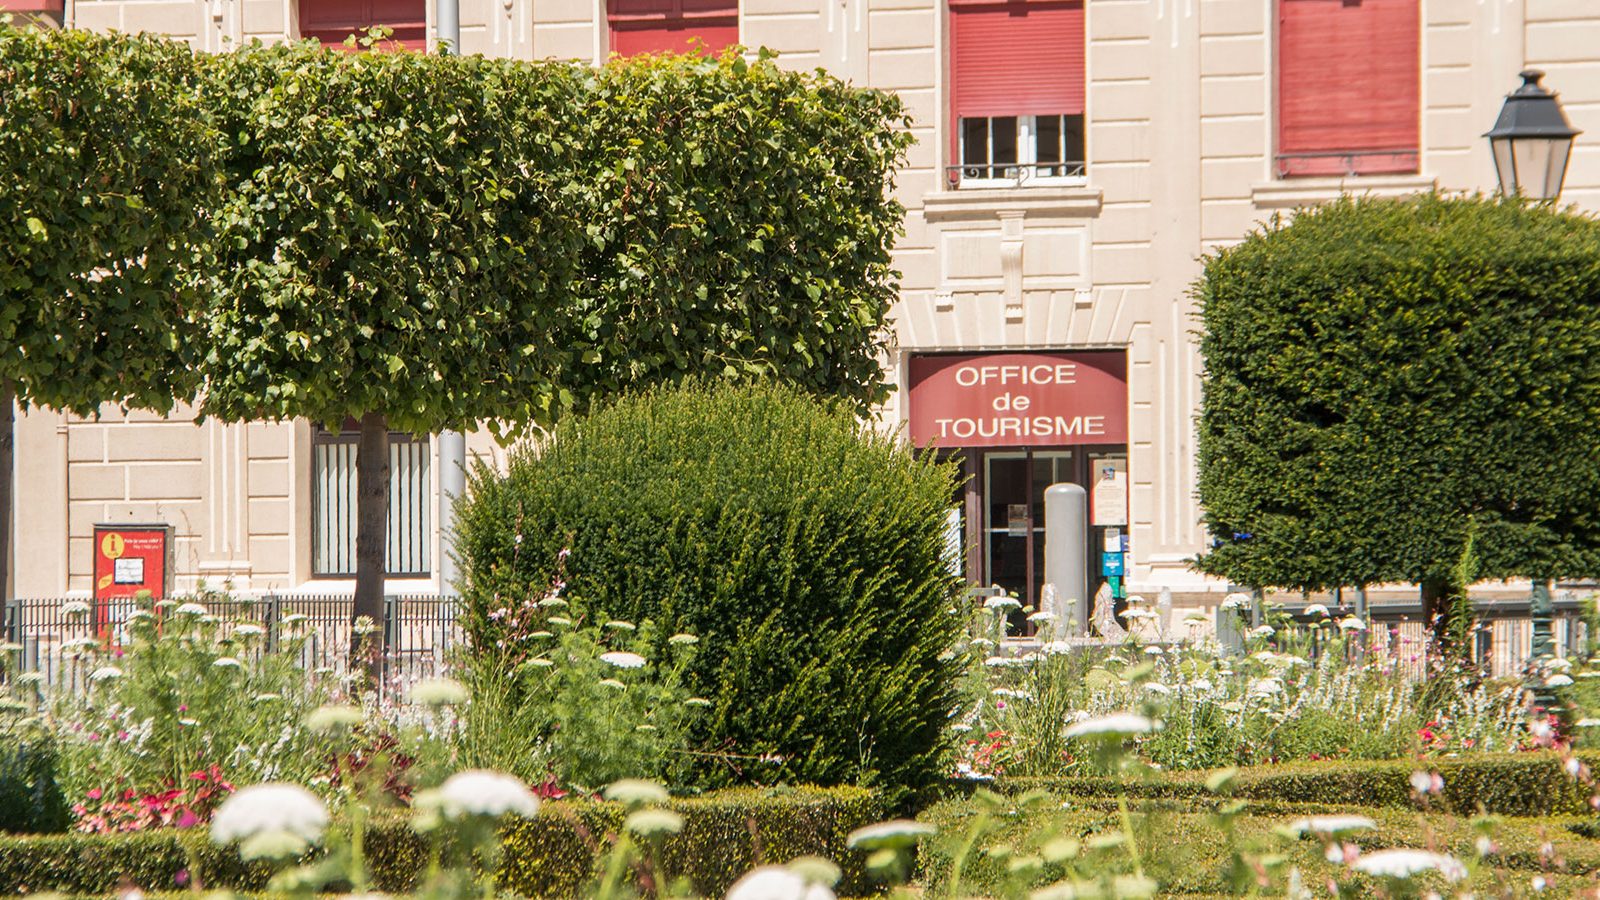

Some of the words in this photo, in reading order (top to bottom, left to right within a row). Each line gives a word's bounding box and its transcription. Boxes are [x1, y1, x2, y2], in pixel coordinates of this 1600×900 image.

[955, 364, 1076, 386] OFFICE
[992, 392, 1031, 411] de
[935, 416, 1105, 438] TOURISME
